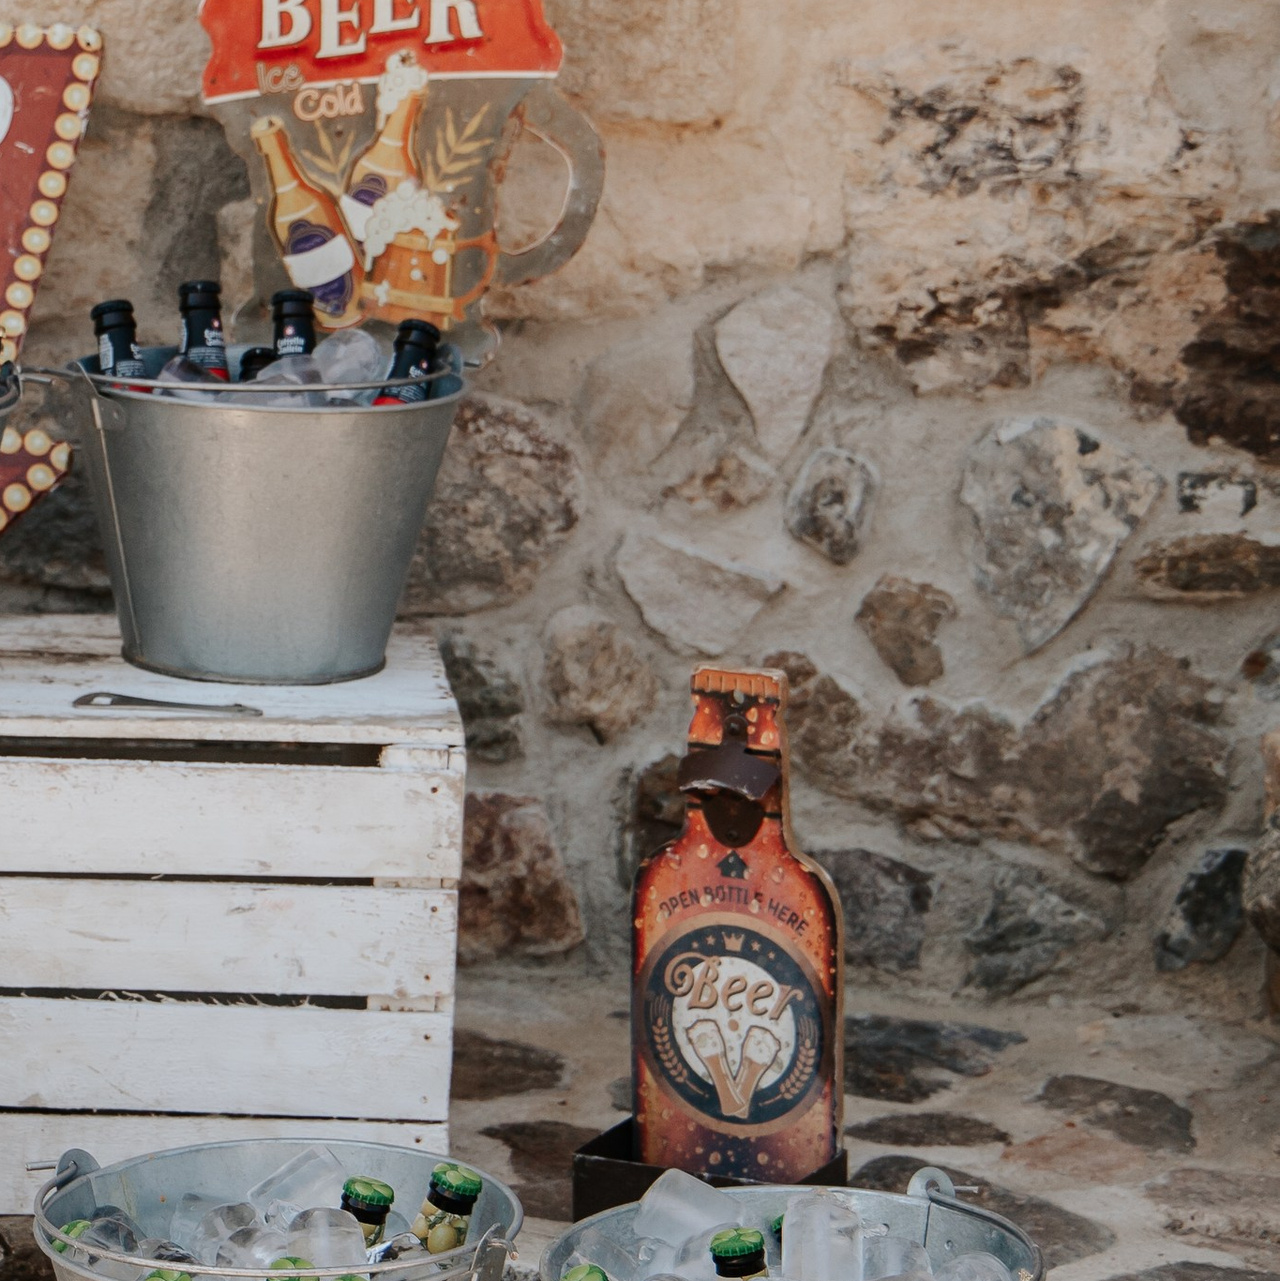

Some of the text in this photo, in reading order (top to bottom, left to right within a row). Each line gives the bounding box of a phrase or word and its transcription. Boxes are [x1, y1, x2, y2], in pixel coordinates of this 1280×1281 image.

[256, 60, 304, 95] Ice
[293, 81, 365, 121] Cold
[658, 885, 809, 937] OPEN BOTTLE HERE
[664, 951, 804, 1021] Beer
